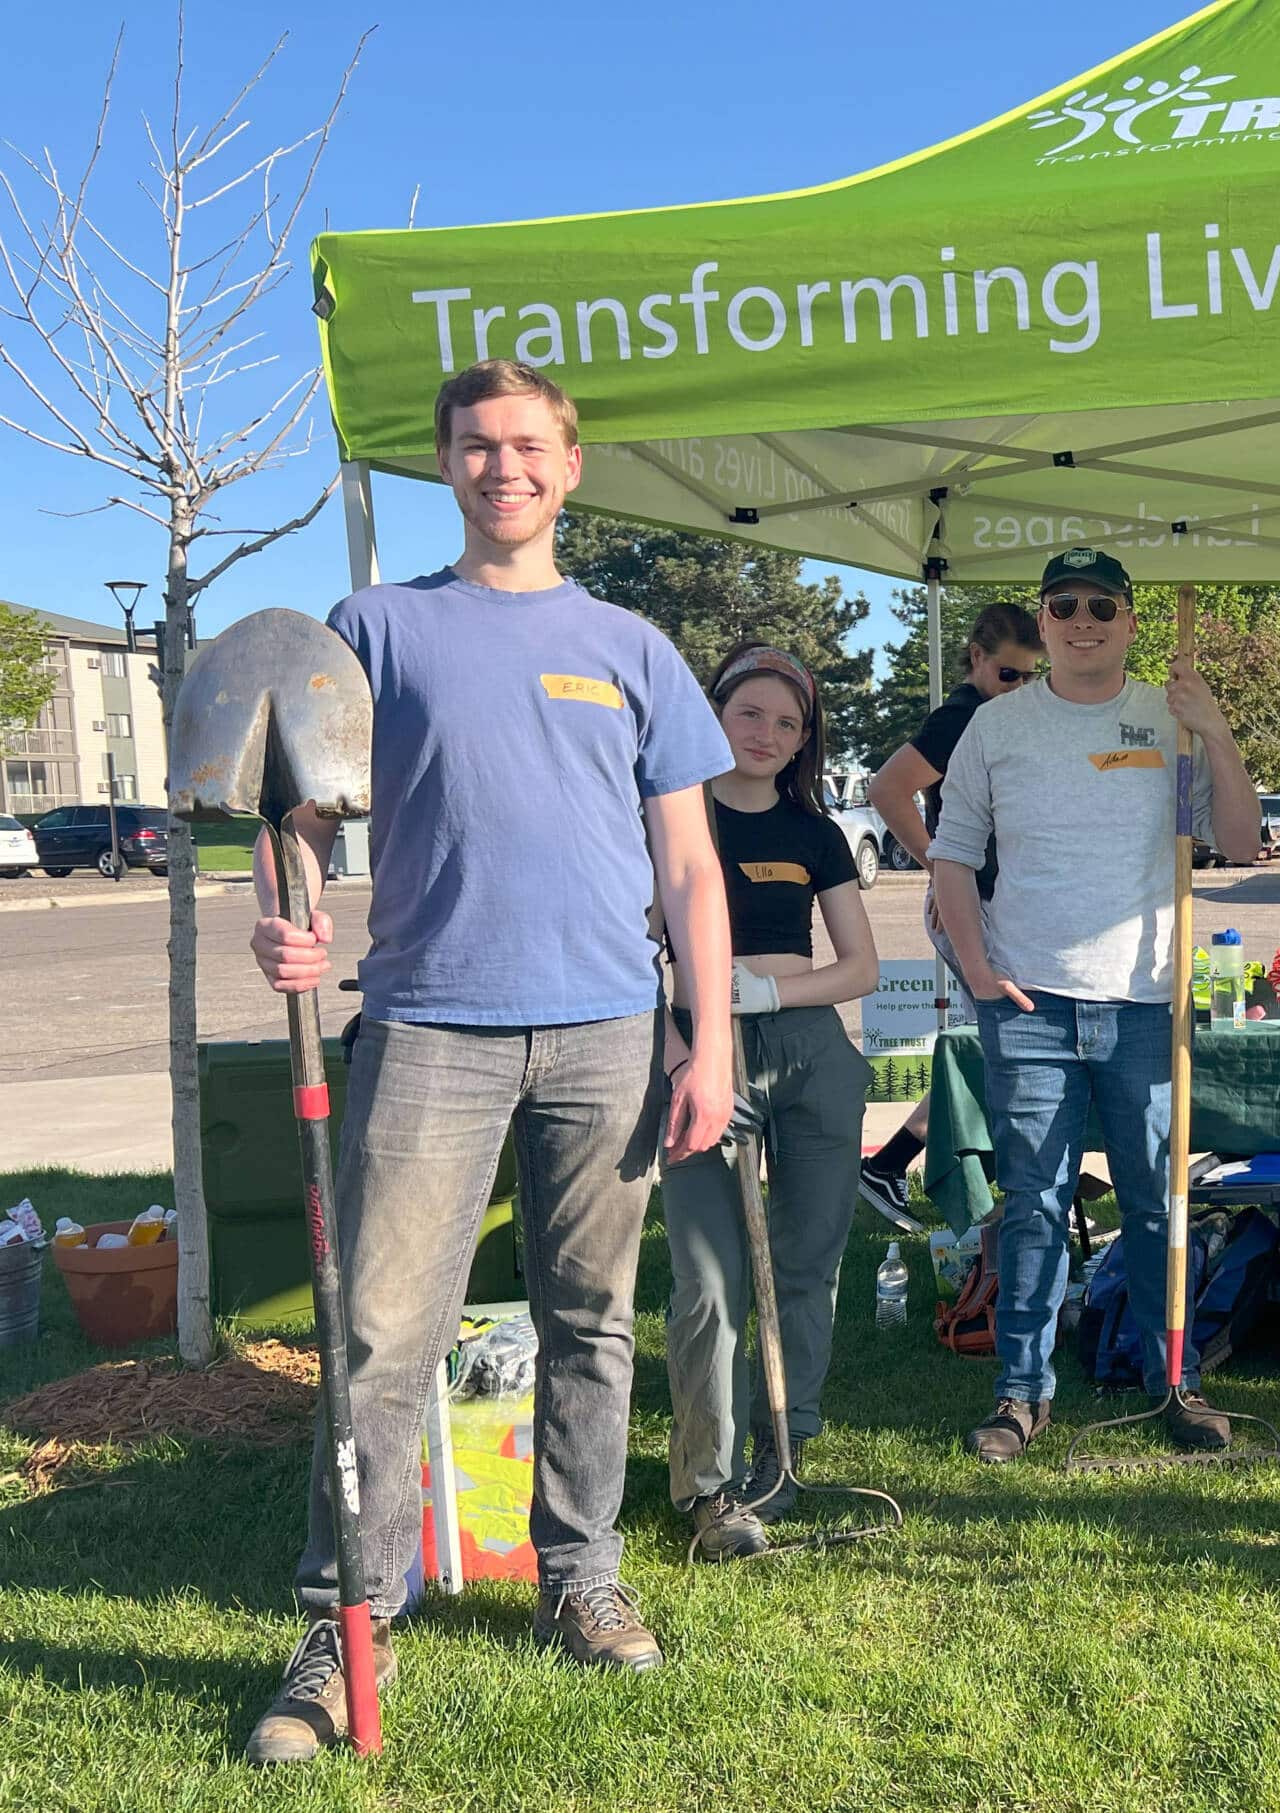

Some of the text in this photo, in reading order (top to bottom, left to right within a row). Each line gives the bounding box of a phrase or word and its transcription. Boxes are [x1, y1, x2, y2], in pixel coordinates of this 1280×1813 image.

[412, 245, 1098, 373] Transforming
[561, 681, 601, 697] ERIC
[876, 1002, 896, 1011] Help
[898, 1003, 921, 1012] grow
[899, 1037, 927, 1047] TRUST
